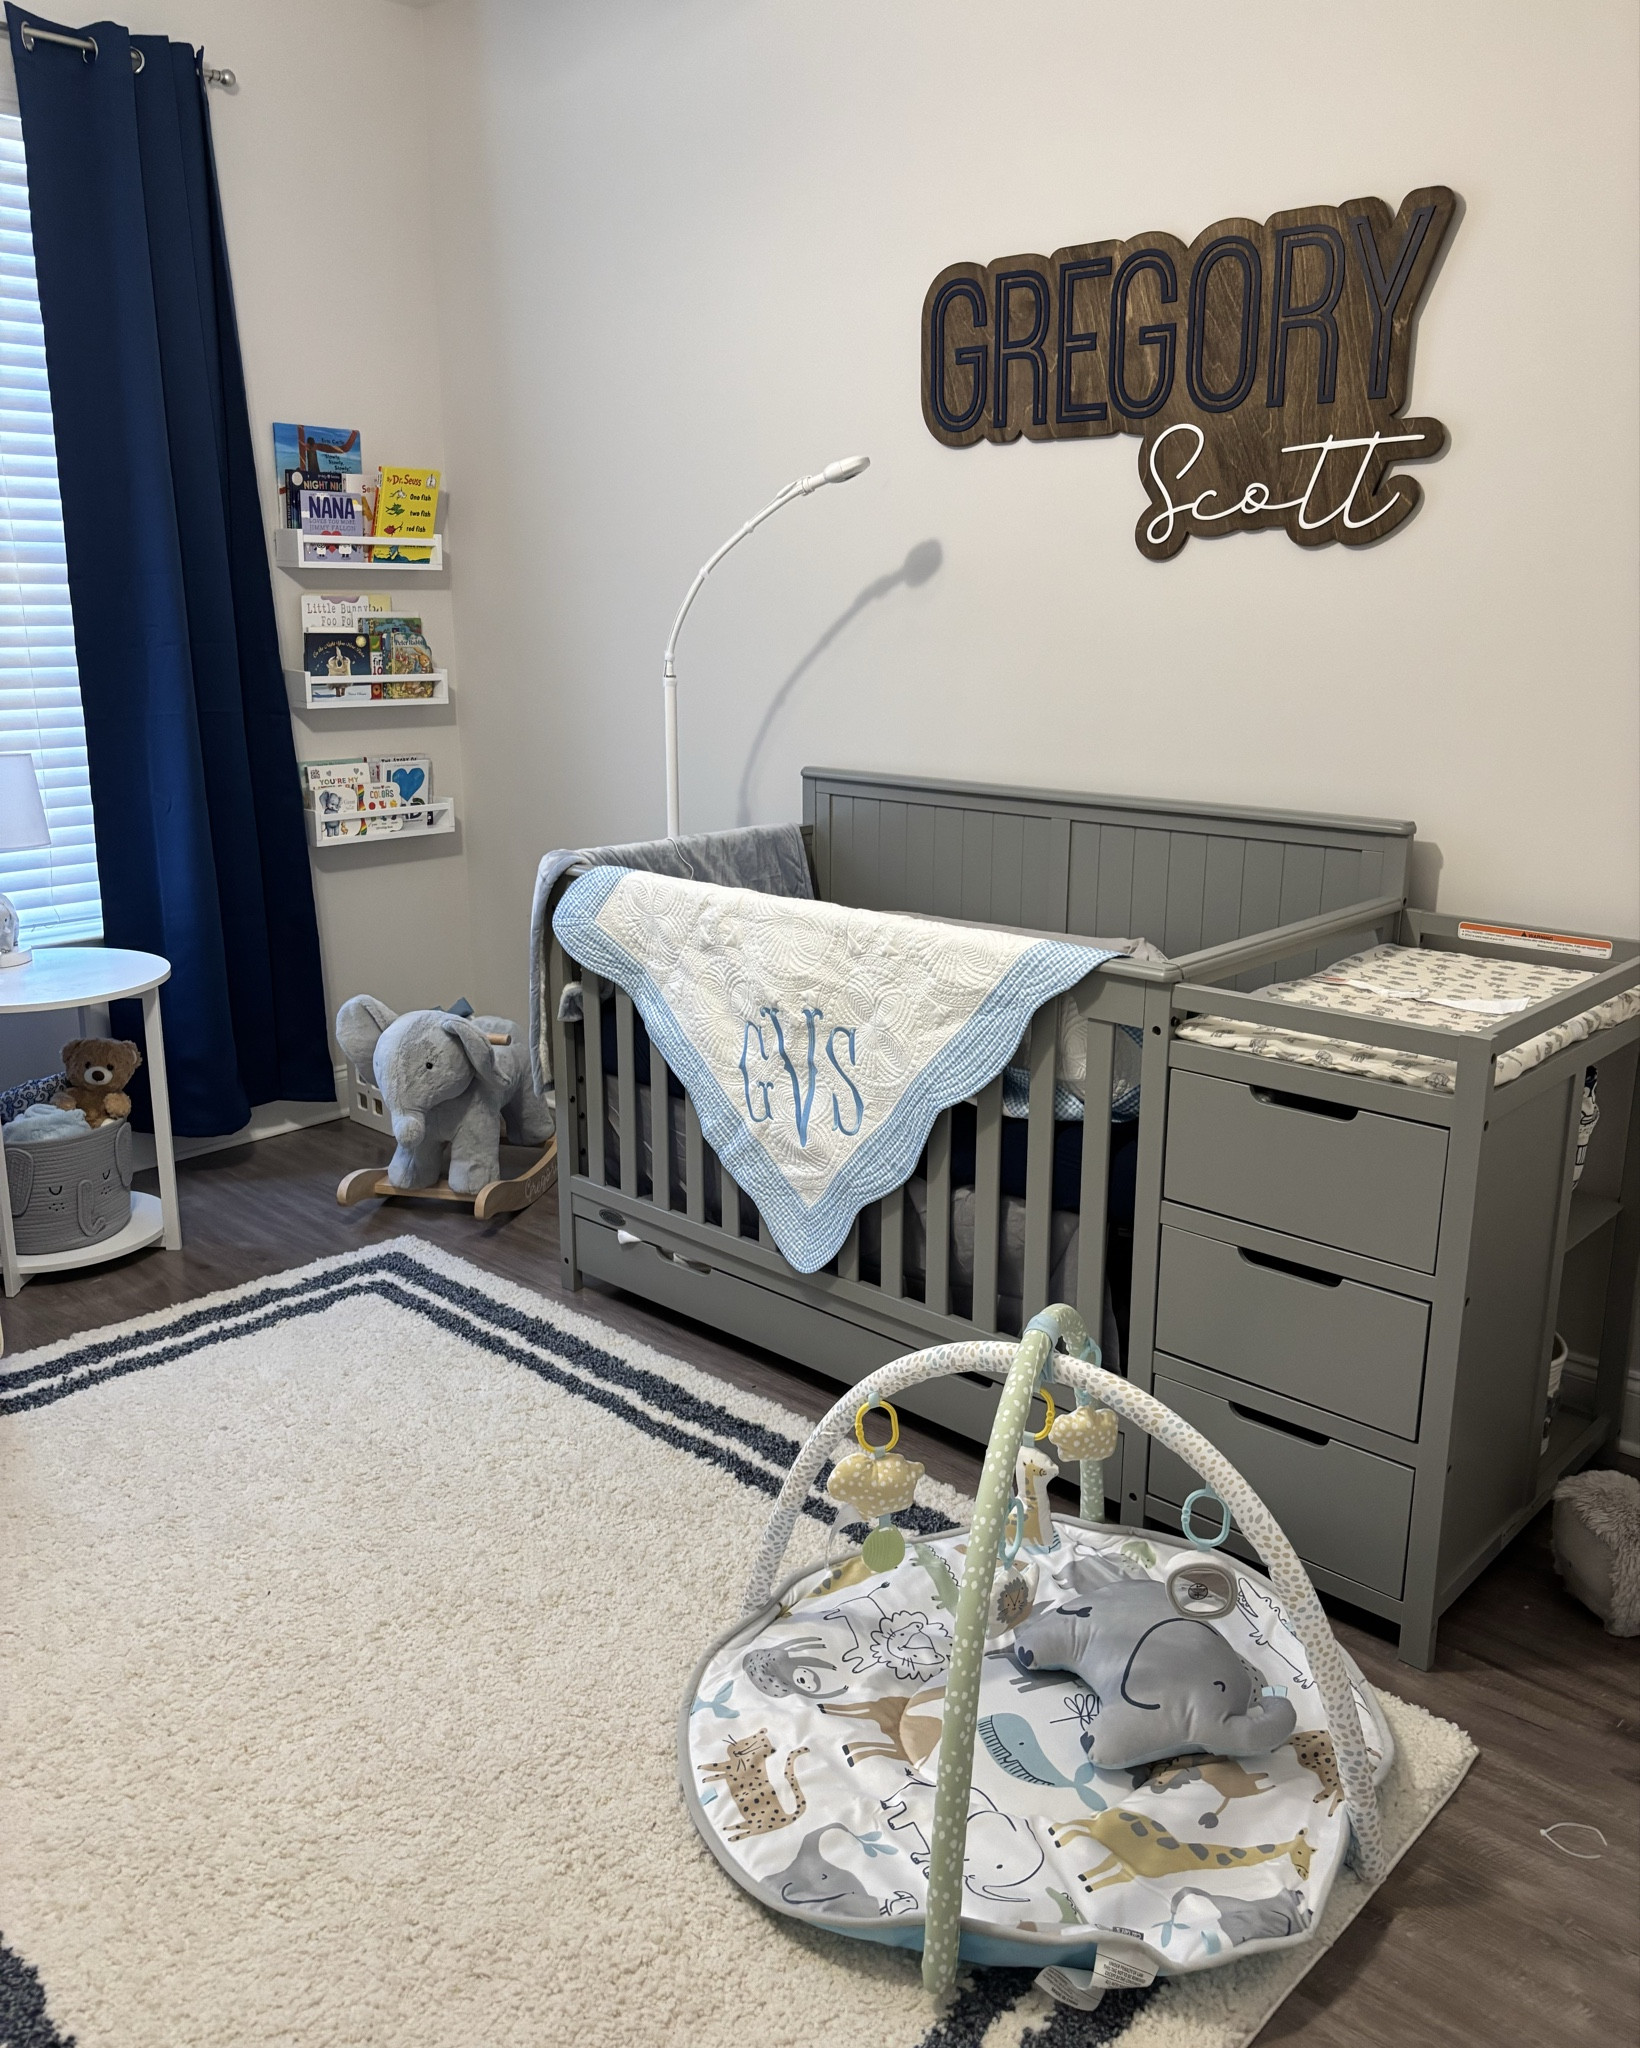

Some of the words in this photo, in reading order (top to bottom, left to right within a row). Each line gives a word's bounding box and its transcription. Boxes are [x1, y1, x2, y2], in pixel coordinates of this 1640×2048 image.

[930, 205, 1436, 433] GREGORY
[303, 480, 328, 490] NIGHT
[392, 474, 403, 485] Dr.
[404, 474, 422, 486] Seuss
[1146, 423, 1426, 545] Scott
[309, 496, 355, 519] NANA
[307, 603, 336, 614] Little
[321, 616, 337, 626] Foo
[319, 777, 347, 785] YOU'RE
[370, 790, 394, 799] COLORS
[1528, 933, 1554, 941] WARNING
